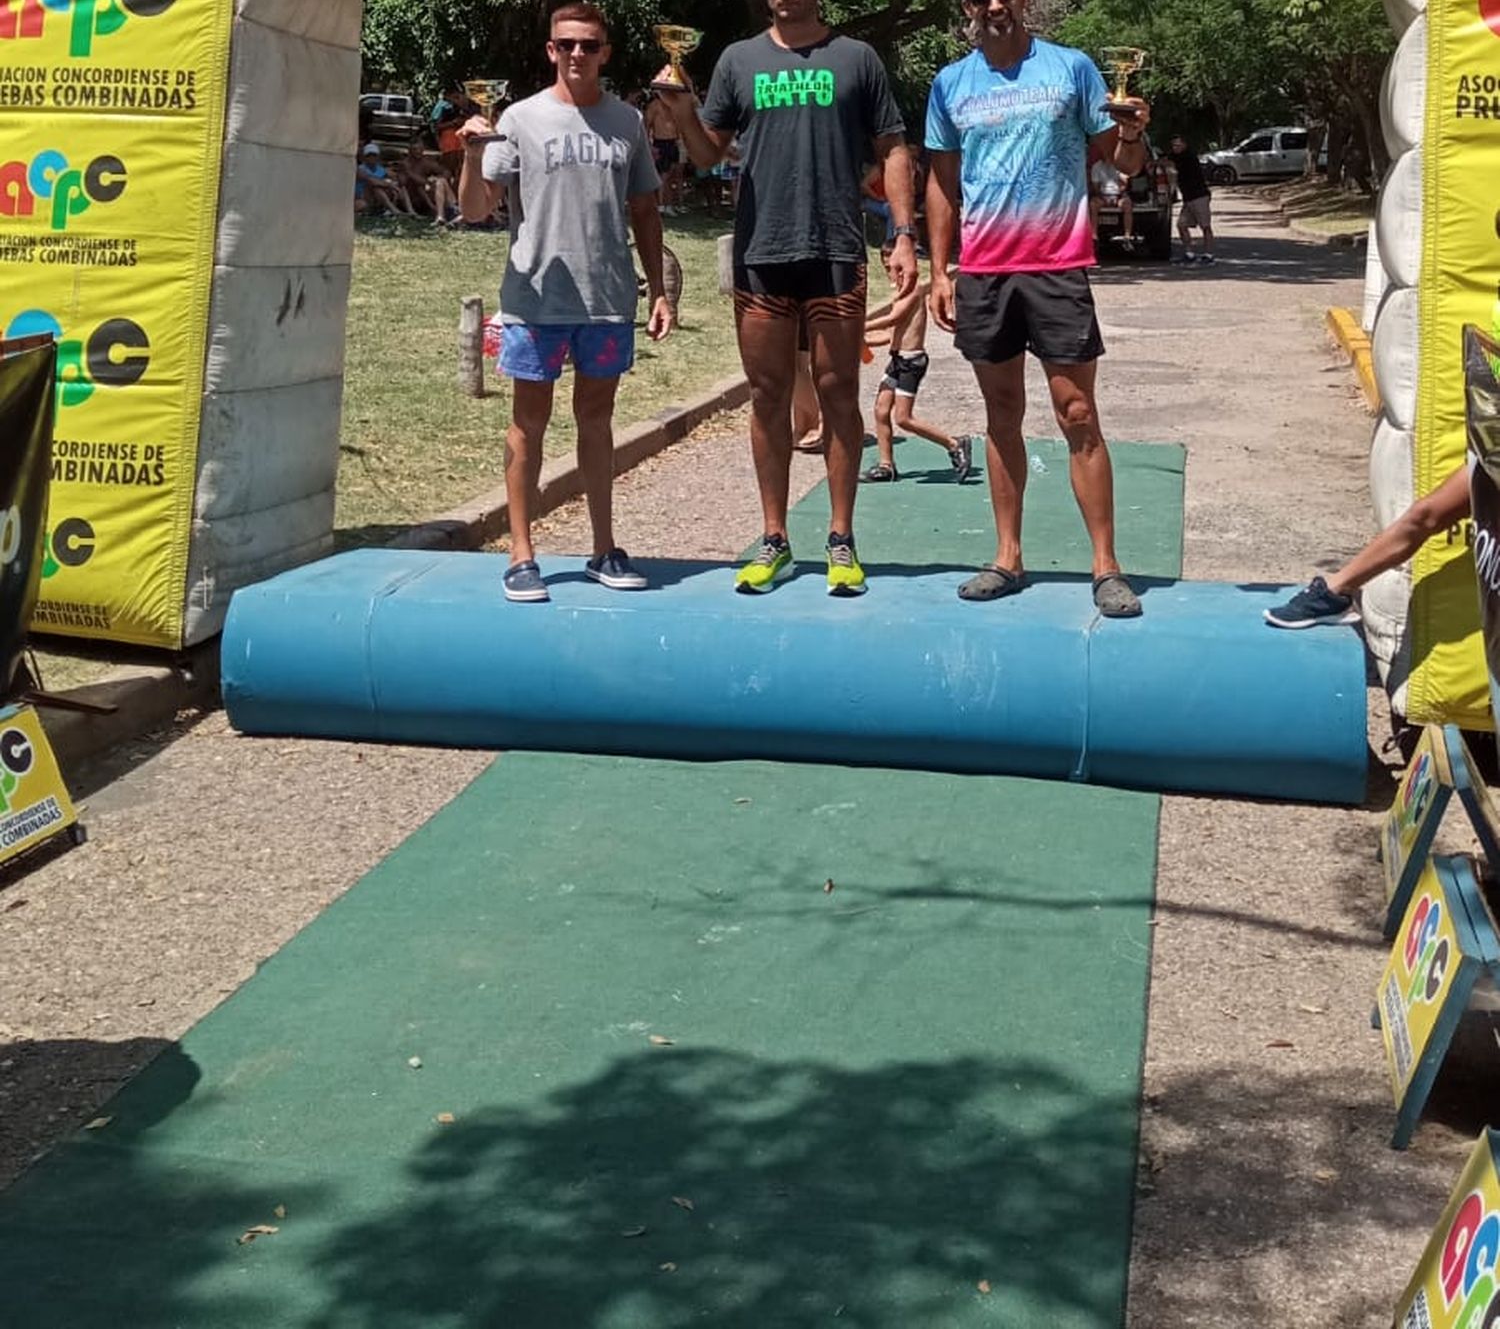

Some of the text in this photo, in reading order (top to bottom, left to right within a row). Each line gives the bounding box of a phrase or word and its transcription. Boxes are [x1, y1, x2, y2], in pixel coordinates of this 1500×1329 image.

[52, 67, 169, 86] CONCORDIENSE
[175, 70, 196, 86] DE
[52, 84, 197, 109] COMBINADAS
[124, 238, 137, 251] DE
[39, 248, 138, 267] COMBINADAS
[144, 445, 165, 462] DE
